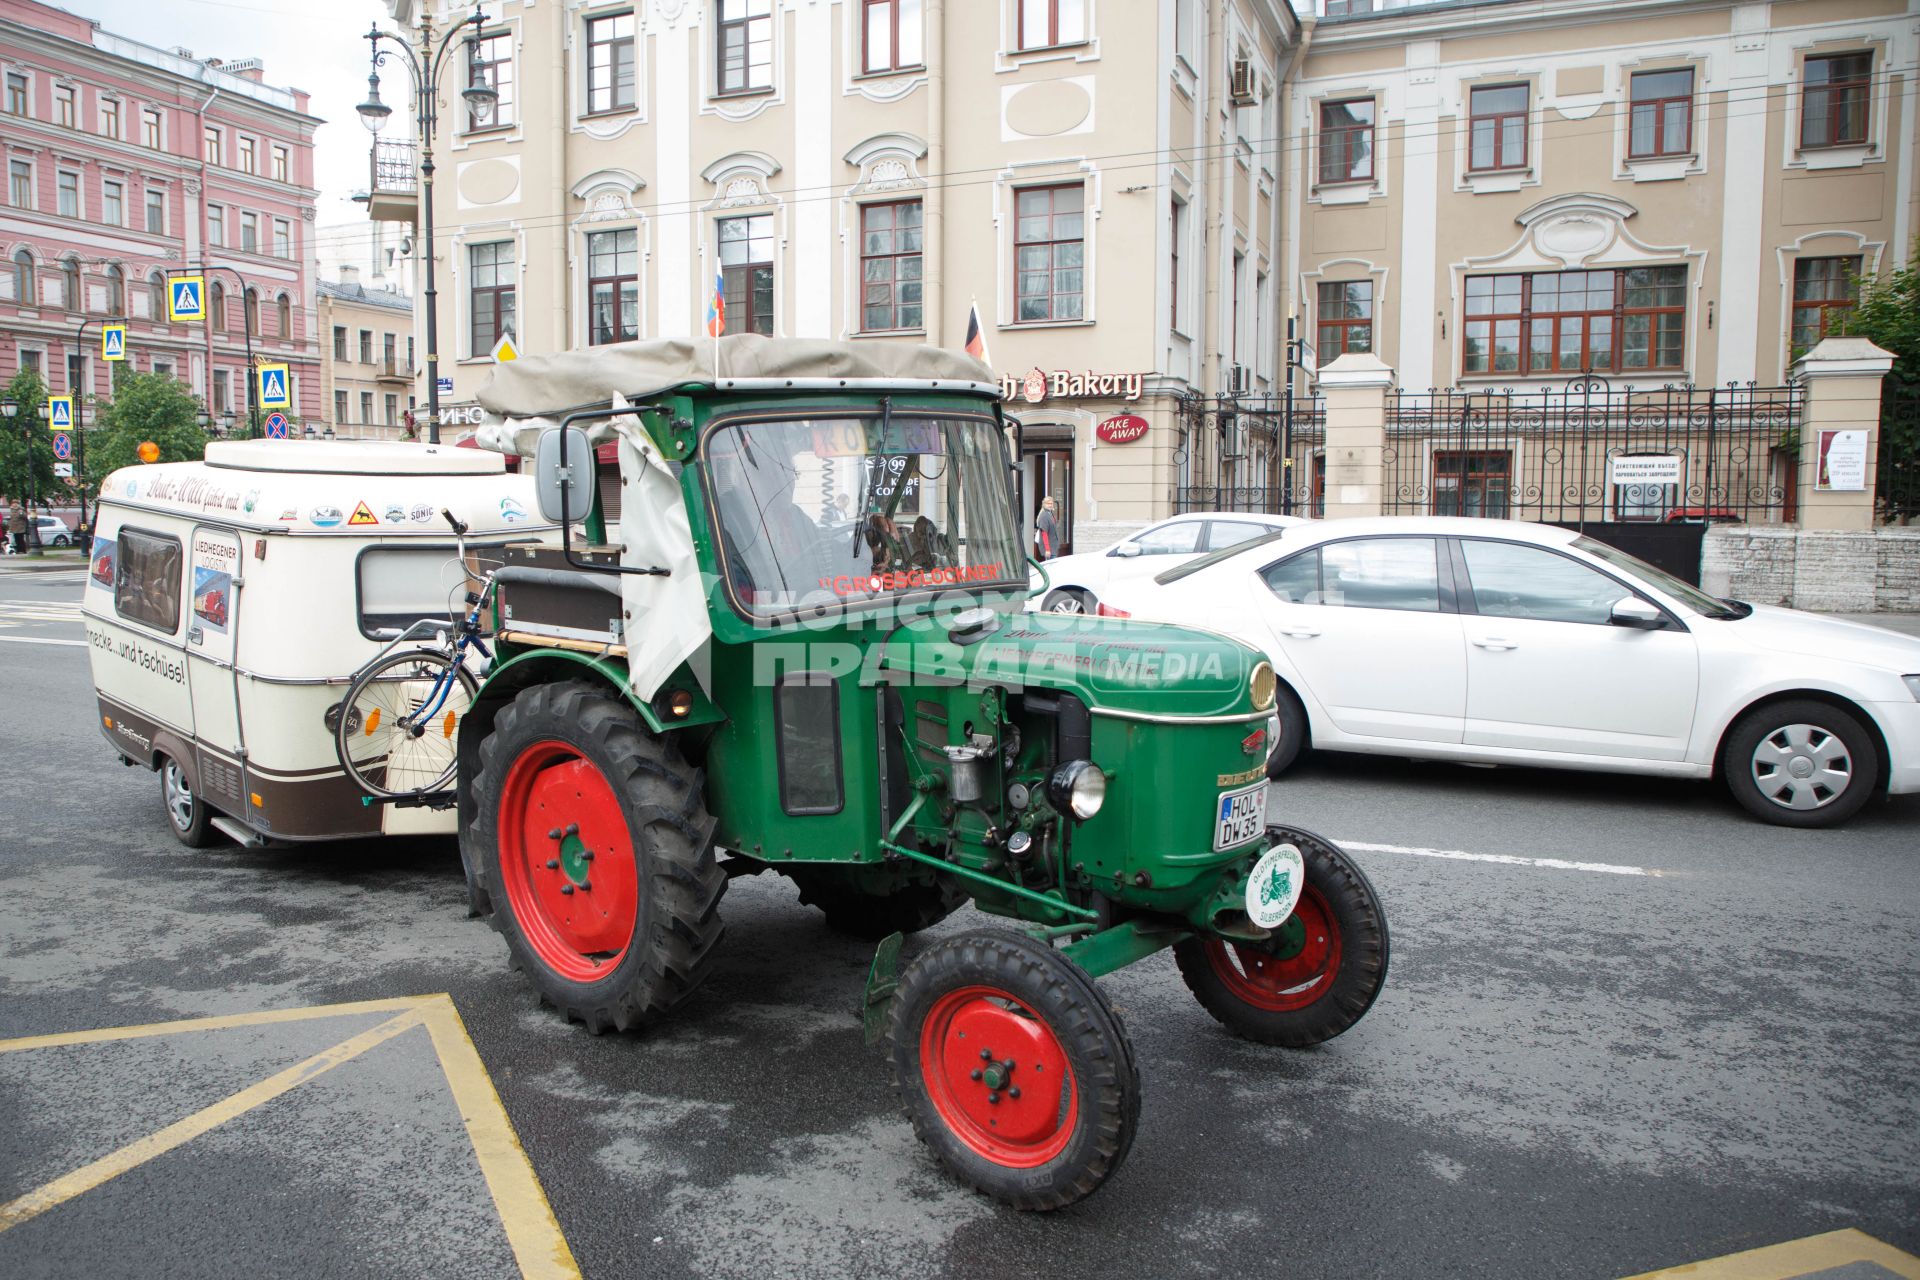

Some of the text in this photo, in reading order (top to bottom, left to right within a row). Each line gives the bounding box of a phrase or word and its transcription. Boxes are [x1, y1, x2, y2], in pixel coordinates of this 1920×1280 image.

[1051, 370, 1143, 401] Bakery
[1102, 418, 1129, 431] TAKE
[1110, 425, 1143, 440] AWAY
[891, 477, 919, 486] КФЕ
[411, 507, 434, 521] SONIC
[195, 540, 237, 560] LIEDHEGENER
[200, 556, 228, 572] LOGISTIK
[138, 648, 186, 685] tschüss!
[1231, 796, 1256, 819] HOL
[1222, 815, 1258, 845] DW 35
